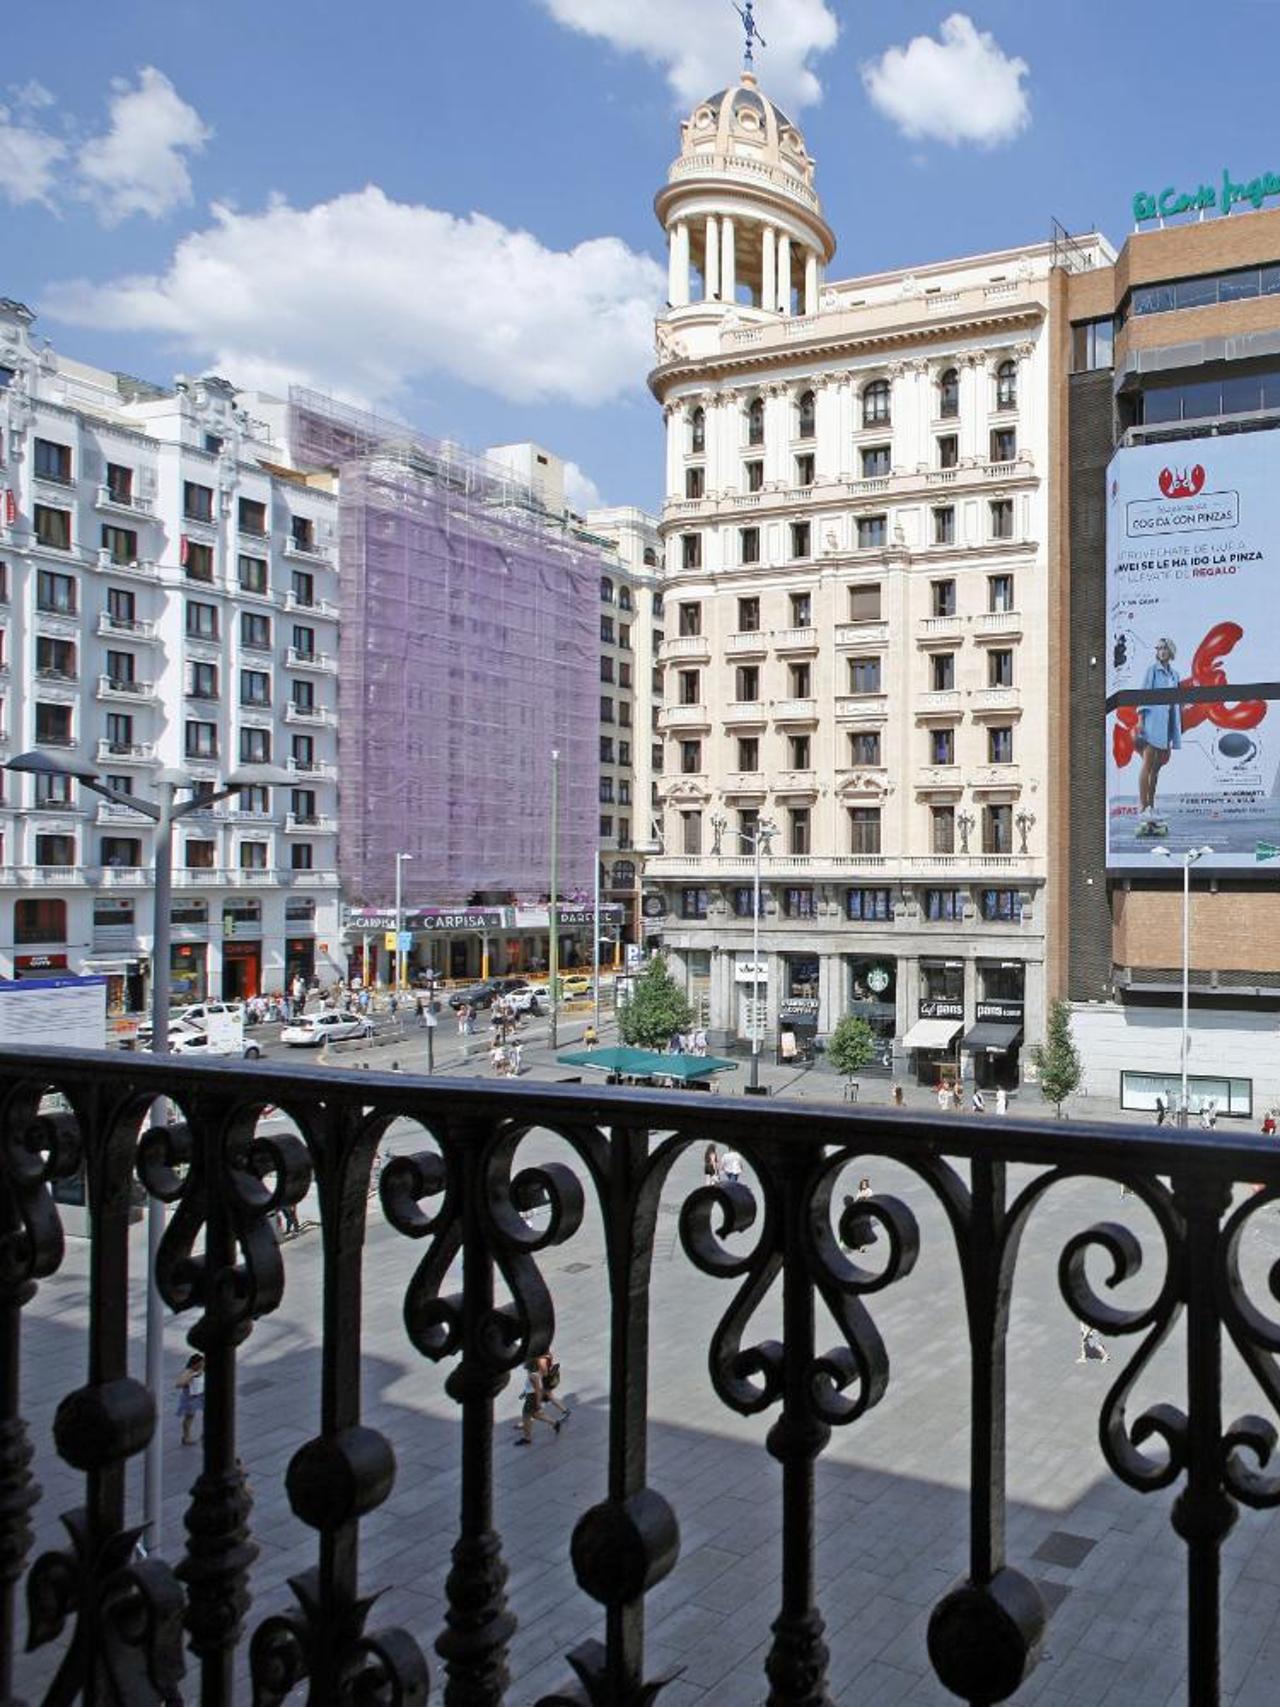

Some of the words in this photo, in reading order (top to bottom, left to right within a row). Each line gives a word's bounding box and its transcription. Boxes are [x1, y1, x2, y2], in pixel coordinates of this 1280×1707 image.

[1133, 190, 1156, 222] El
[1158, 184, 1216, 217] Corte
[1190, 555, 1209, 566] IDO
[1212, 553, 1226, 564] LA
[1229, 551, 1263, 563] PINZA
[423, 915, 486, 930] CARPISA
[937, 1005, 963, 1016] pans
[978, 1005, 1003, 1018] pans
